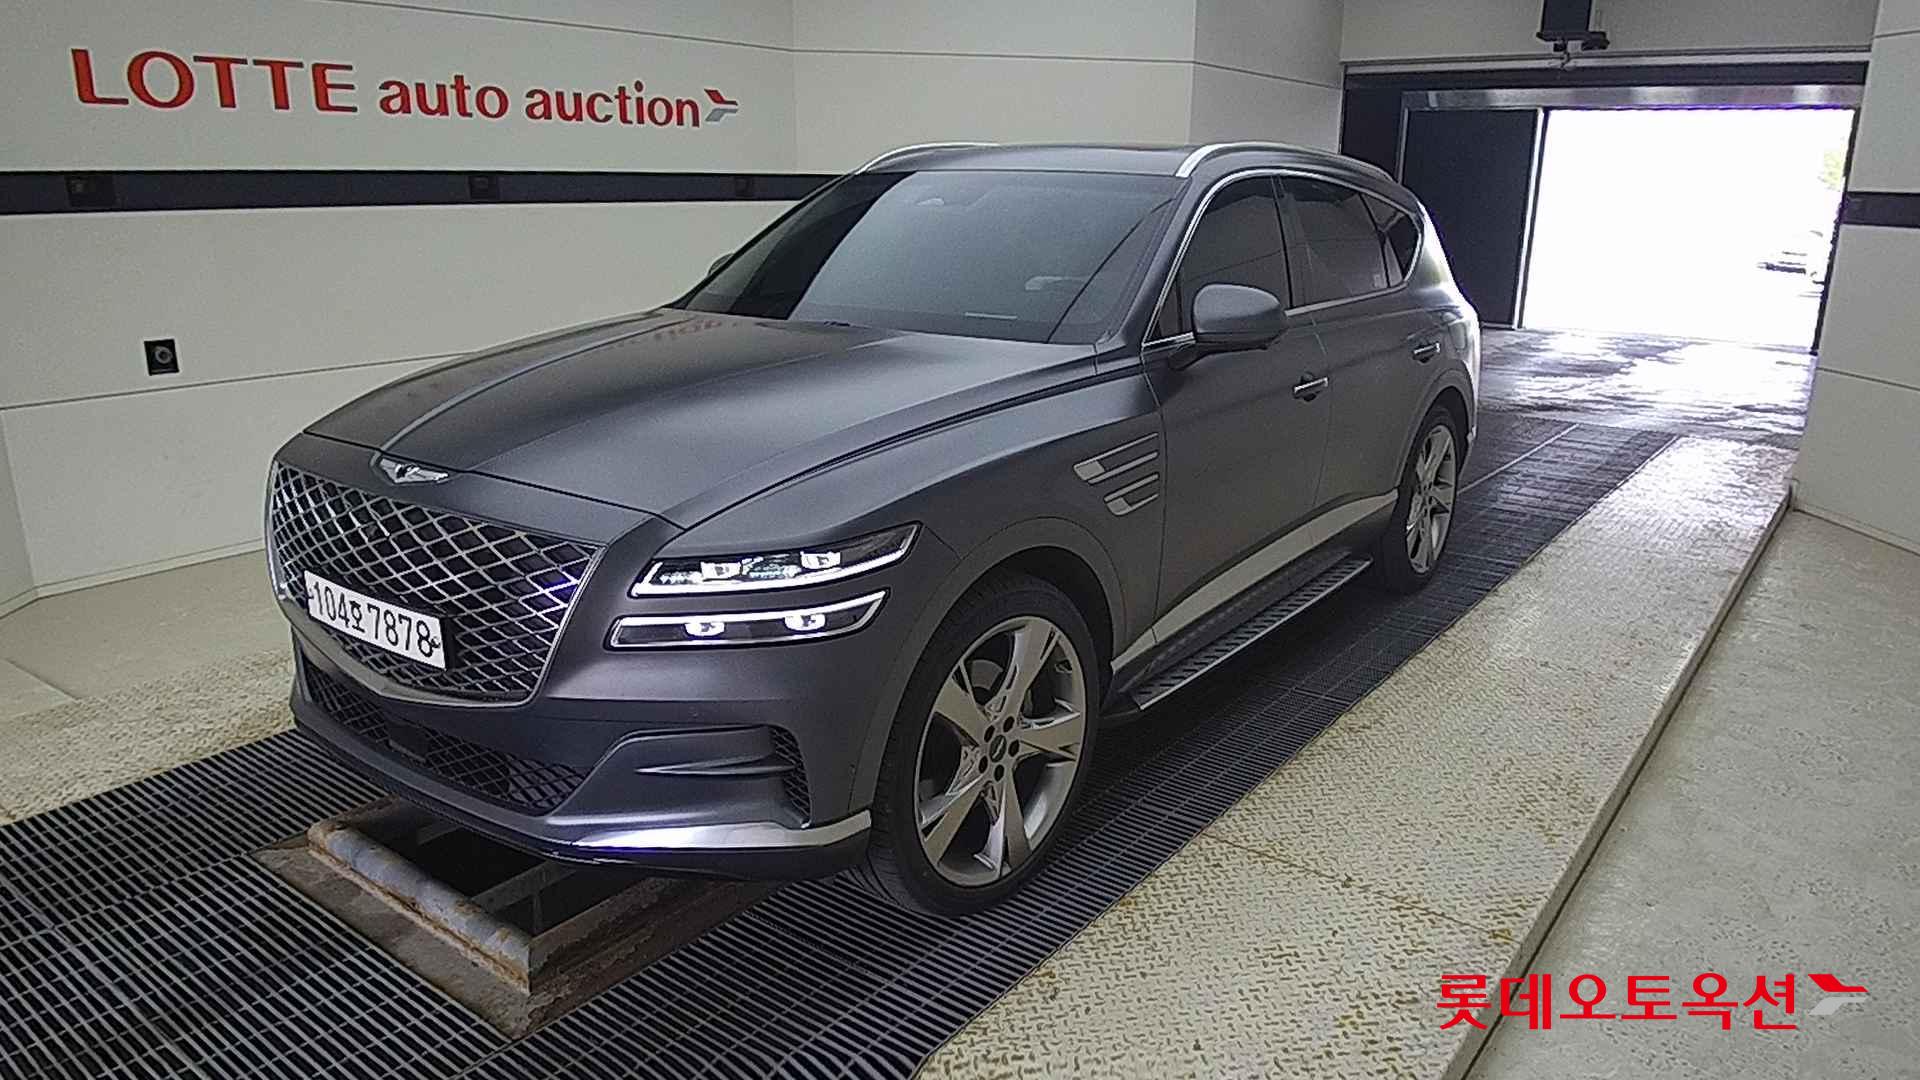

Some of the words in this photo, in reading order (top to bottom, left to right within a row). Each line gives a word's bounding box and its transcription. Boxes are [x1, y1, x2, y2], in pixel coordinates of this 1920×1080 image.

[71, 48, 358, 114] LOTTE
[378, 74, 509, 120] auto
[525, 80, 701, 128] auction
[366, 602, 433, 658] 7878
